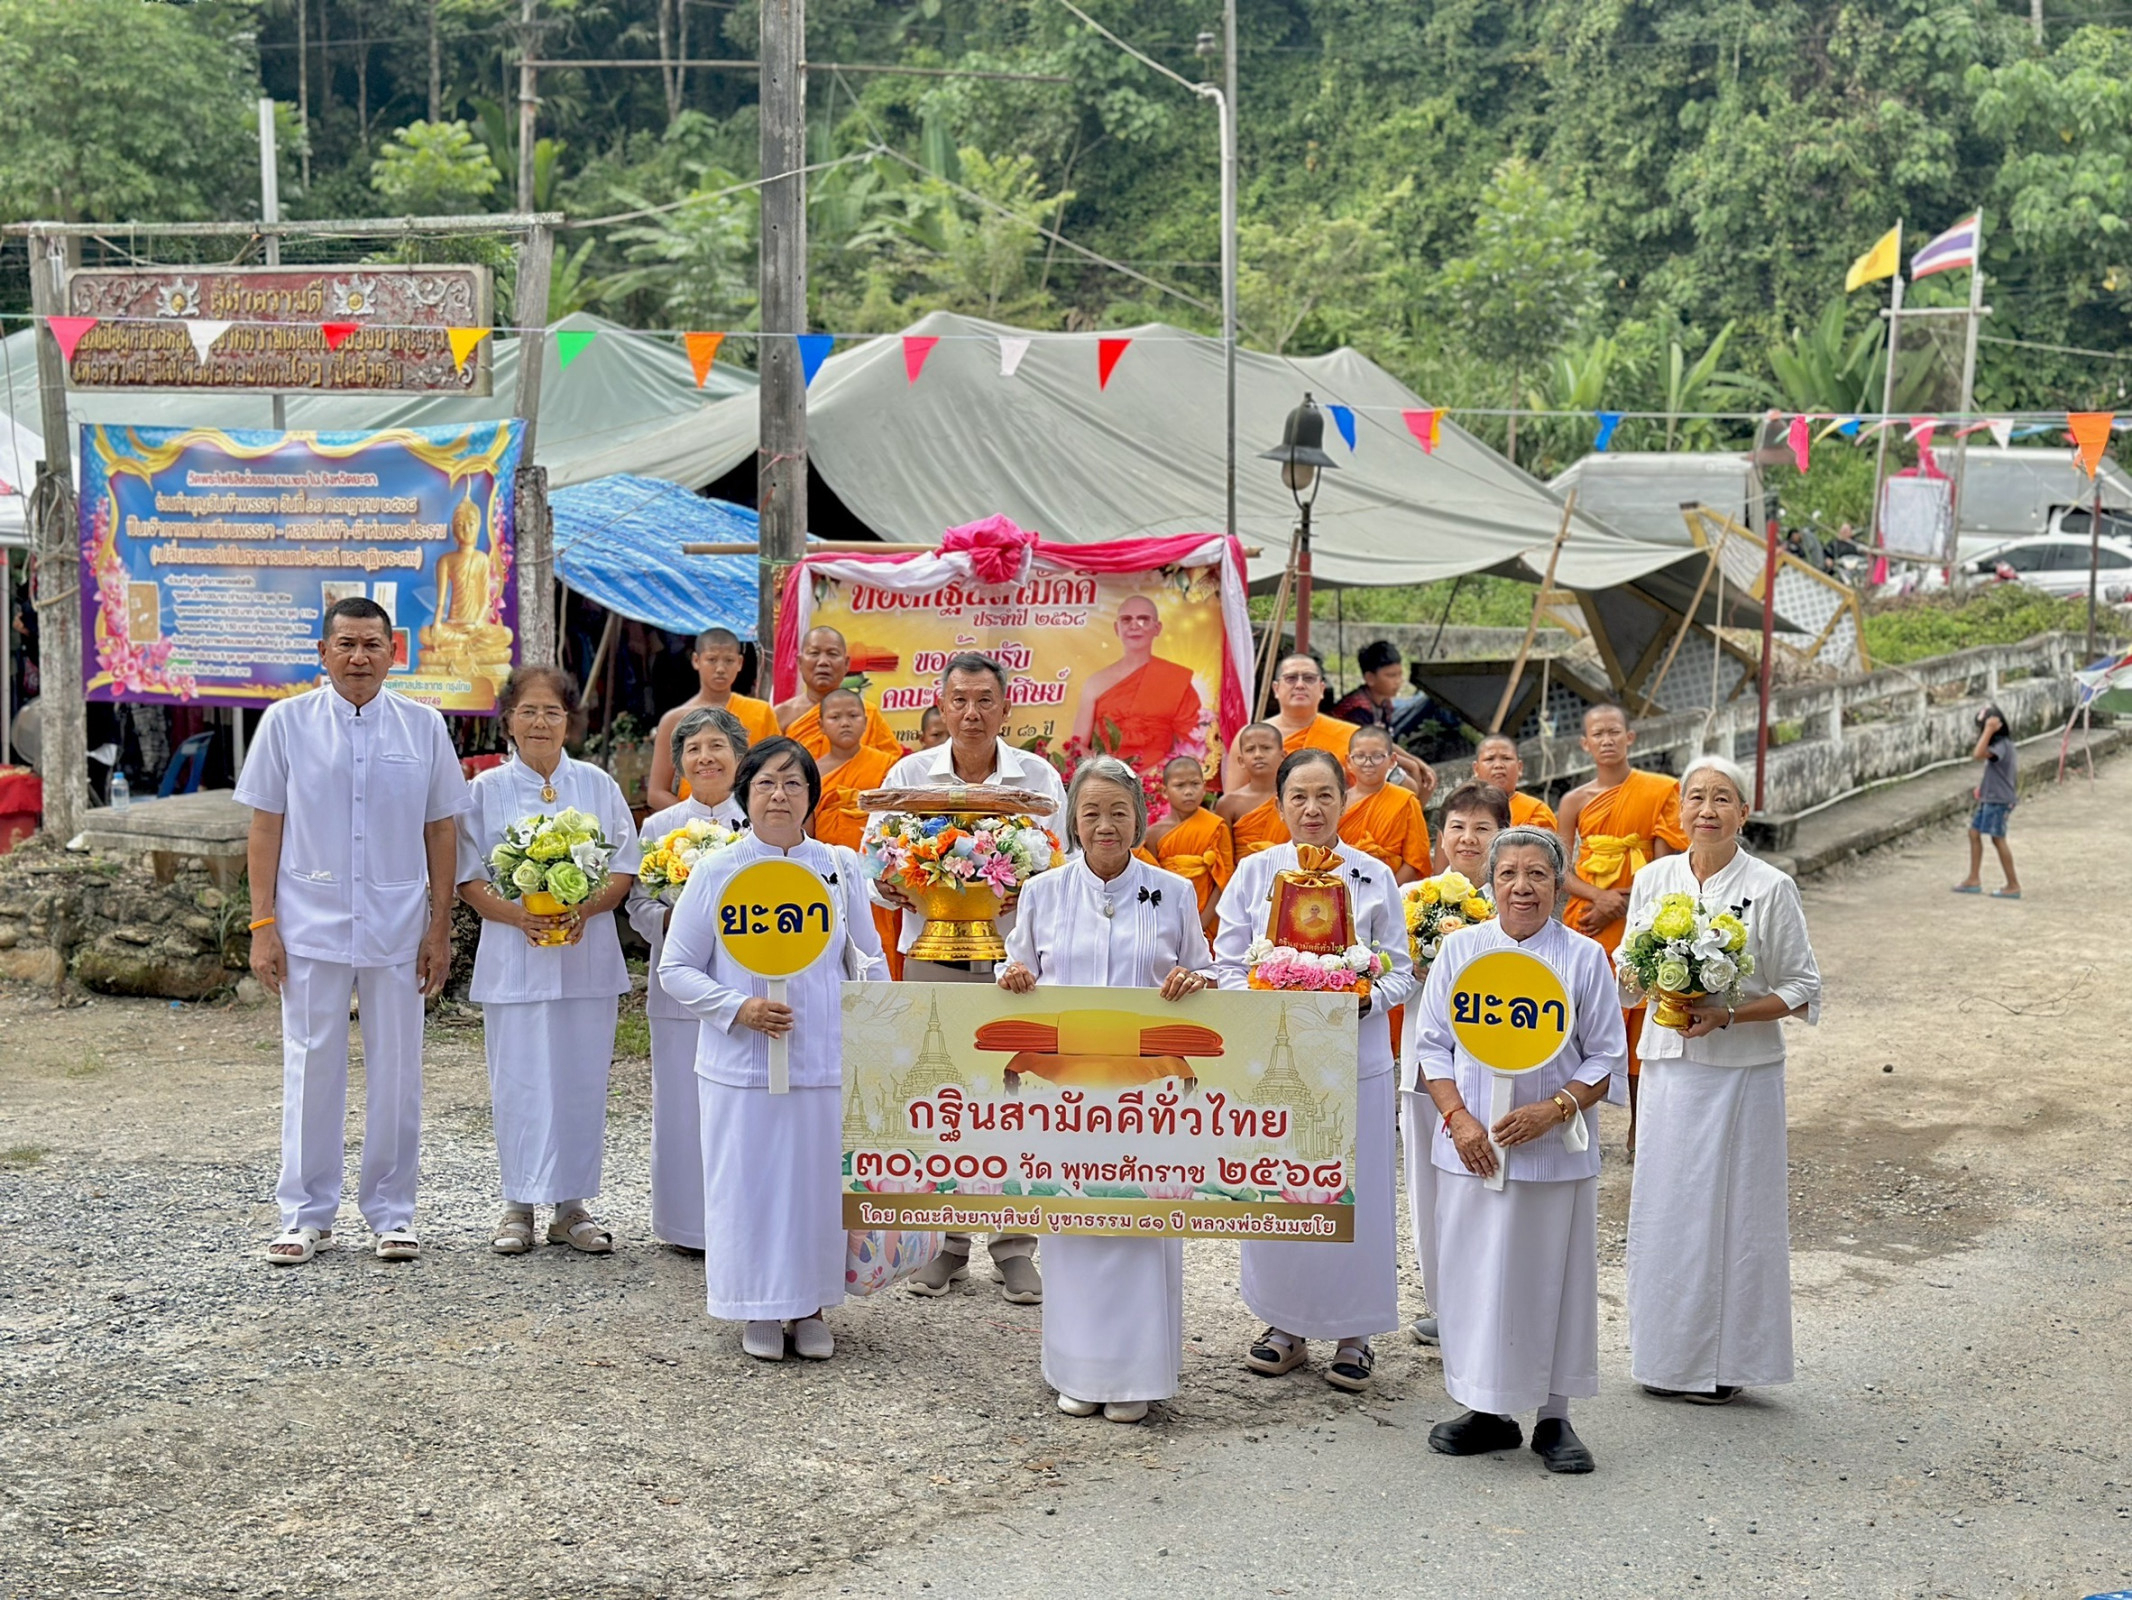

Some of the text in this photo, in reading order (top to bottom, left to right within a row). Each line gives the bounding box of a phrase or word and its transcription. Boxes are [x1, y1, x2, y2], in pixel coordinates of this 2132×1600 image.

[973, 608, 1087, 627] ประจำปี ๒๕๖๘
[720, 901, 829, 936] ยะลา
[1453, 991, 1565, 1032] ยะลา
[908, 1081, 1289, 1142] กฐินสามัคคีทั่วไทย
[856, 1152, 1343, 1190] ๓๐,๐๐๐ วัด พุทธศักราช ๒๕๖๘
[861, 1205, 895, 1224] โดย
[901, 1206, 1040, 1232] คณะศิษยานุศิษย์
[1048, 1212, 1133, 1233] บูชาธรรม
[1138, 1215, 1165, 1231] ๘๑
[1171, 1210, 1184, 1230] ปี
